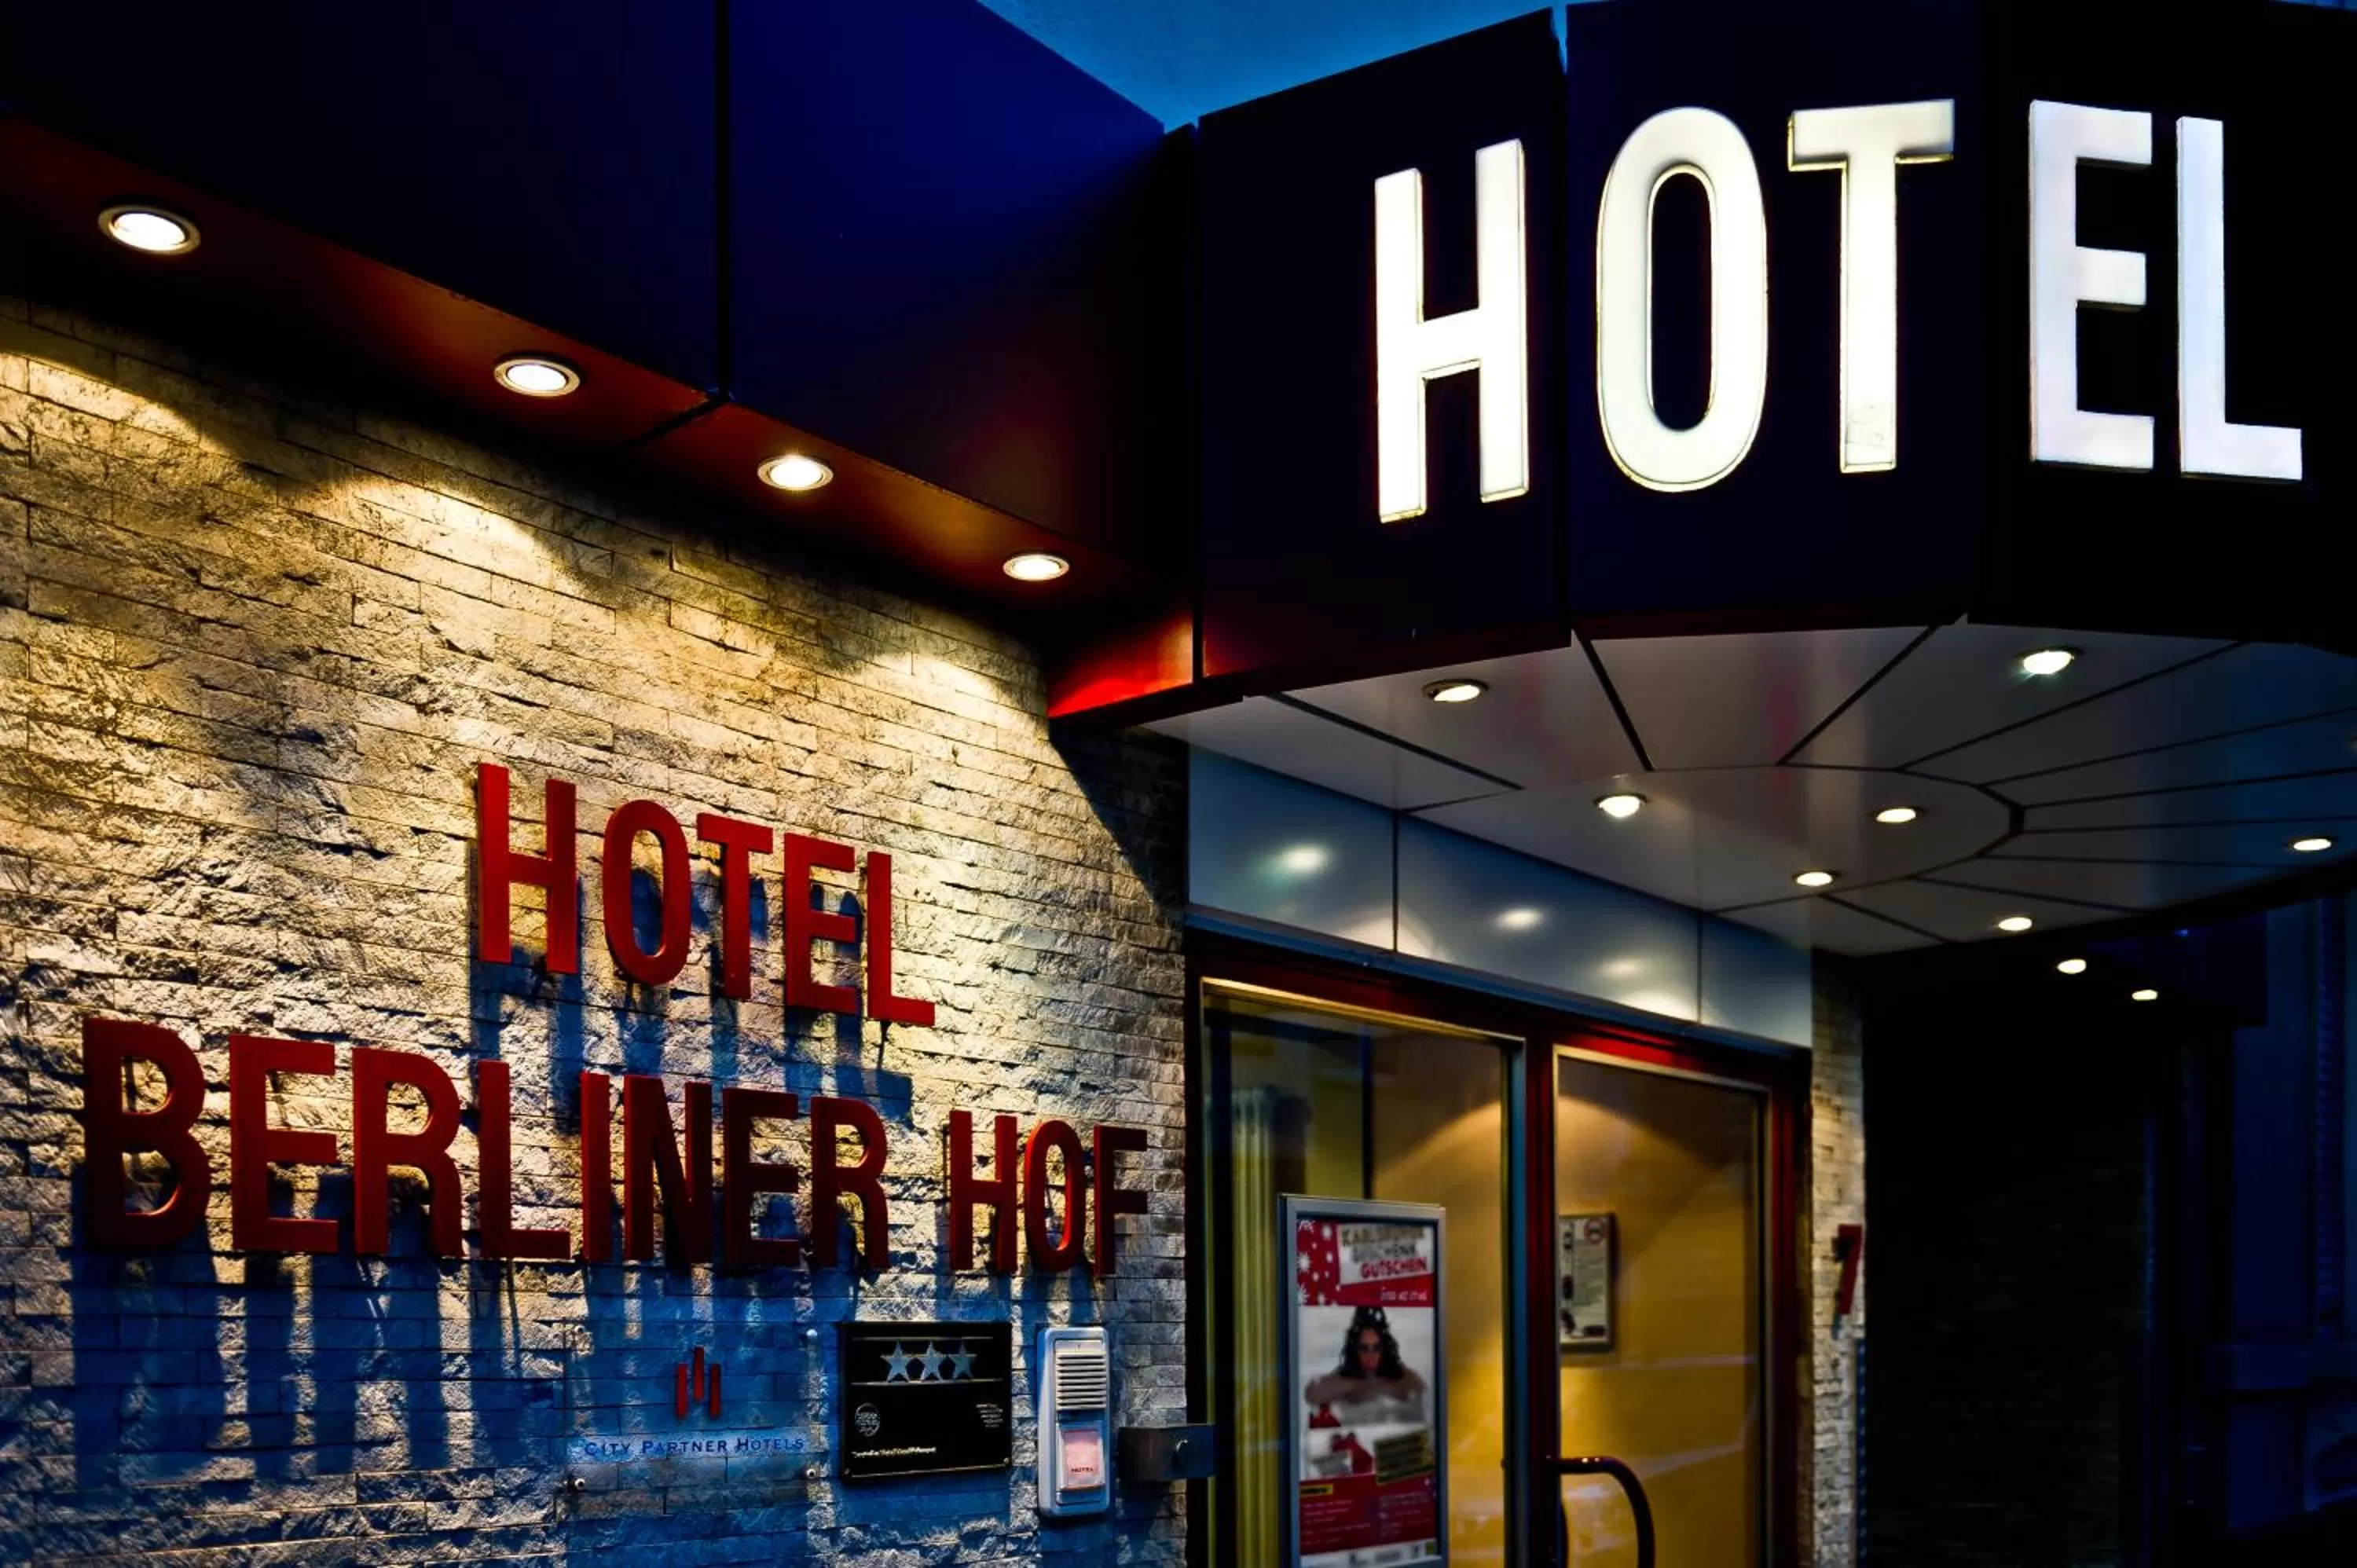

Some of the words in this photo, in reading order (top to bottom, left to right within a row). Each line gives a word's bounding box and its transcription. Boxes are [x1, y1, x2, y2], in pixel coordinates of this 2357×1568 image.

[1375, 99, 2303, 523] HOTEL
[477, 762, 936, 1028] HOTEL
[83, 1017, 891, 1272] BERLINER
[948, 1109, 1147, 1274] HOF
[584, 1442, 629, 1456] CITY
[642, 1440, 728, 1454] PARTNER
[735, 1438, 805, 1452] HOTELS
